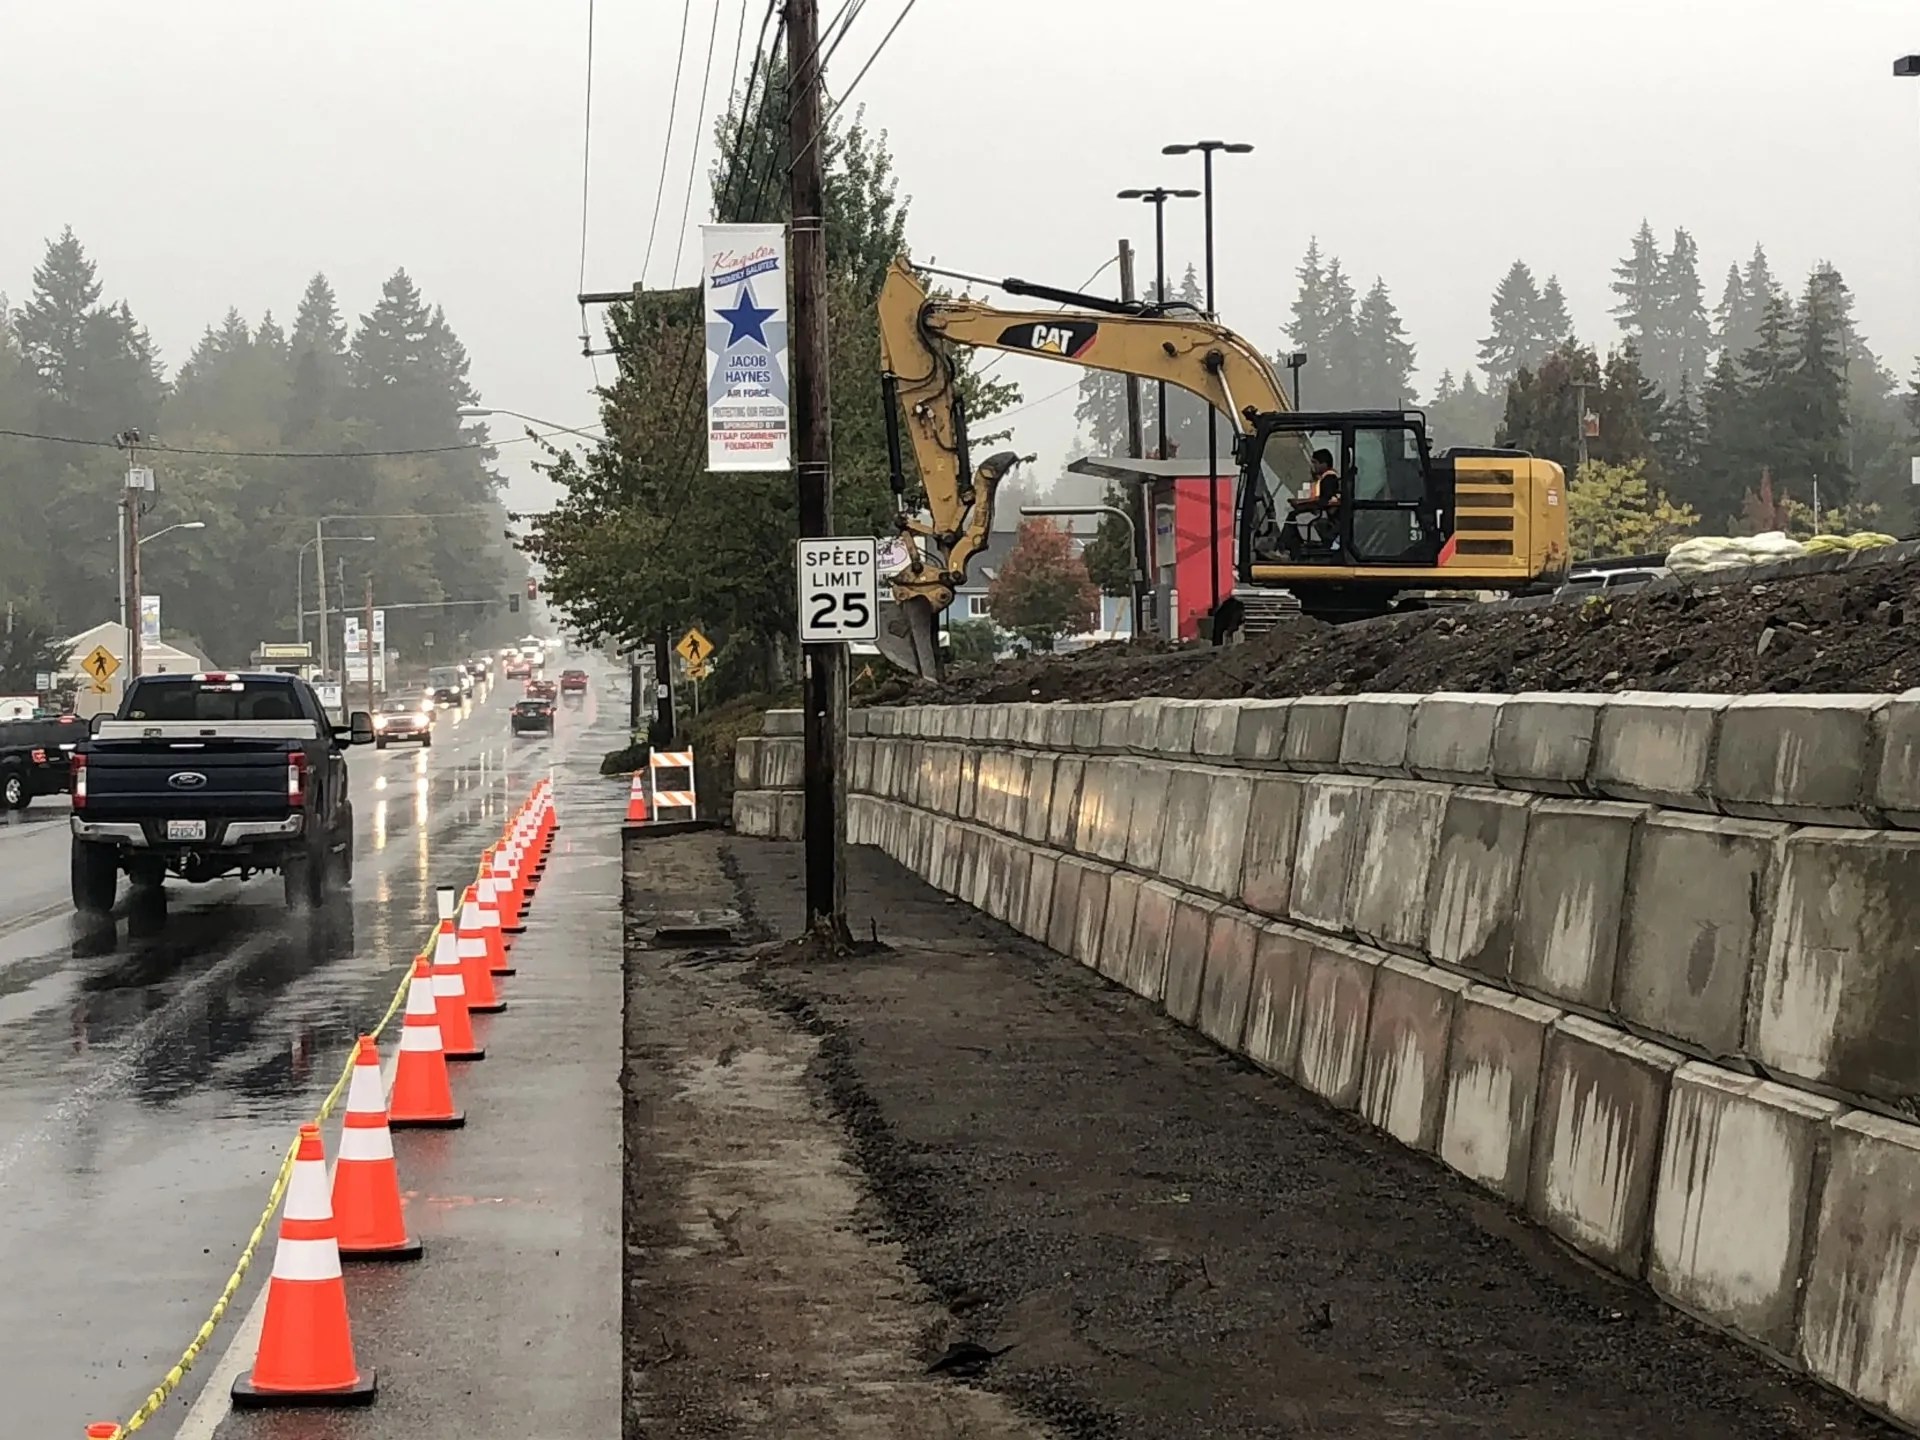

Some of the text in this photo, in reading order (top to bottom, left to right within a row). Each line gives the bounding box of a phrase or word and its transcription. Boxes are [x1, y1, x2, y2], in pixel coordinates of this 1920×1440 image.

[715, 260, 775, 286] PROUDLY SALUTES
[1031, 325, 1073, 354] CAT
[729, 355, 766, 367] JACOB
[725, 371, 771, 382] HAYNES
[727, 389, 769, 397] AIR FORCE
[710, 432, 788, 440] KITSAP COMMUNITY
[724, 442, 774, 450] FOUNDATION
[805, 551, 870, 566] SPEED
[813, 571, 863, 587] LIMIT
[810, 592, 870, 629] 25
